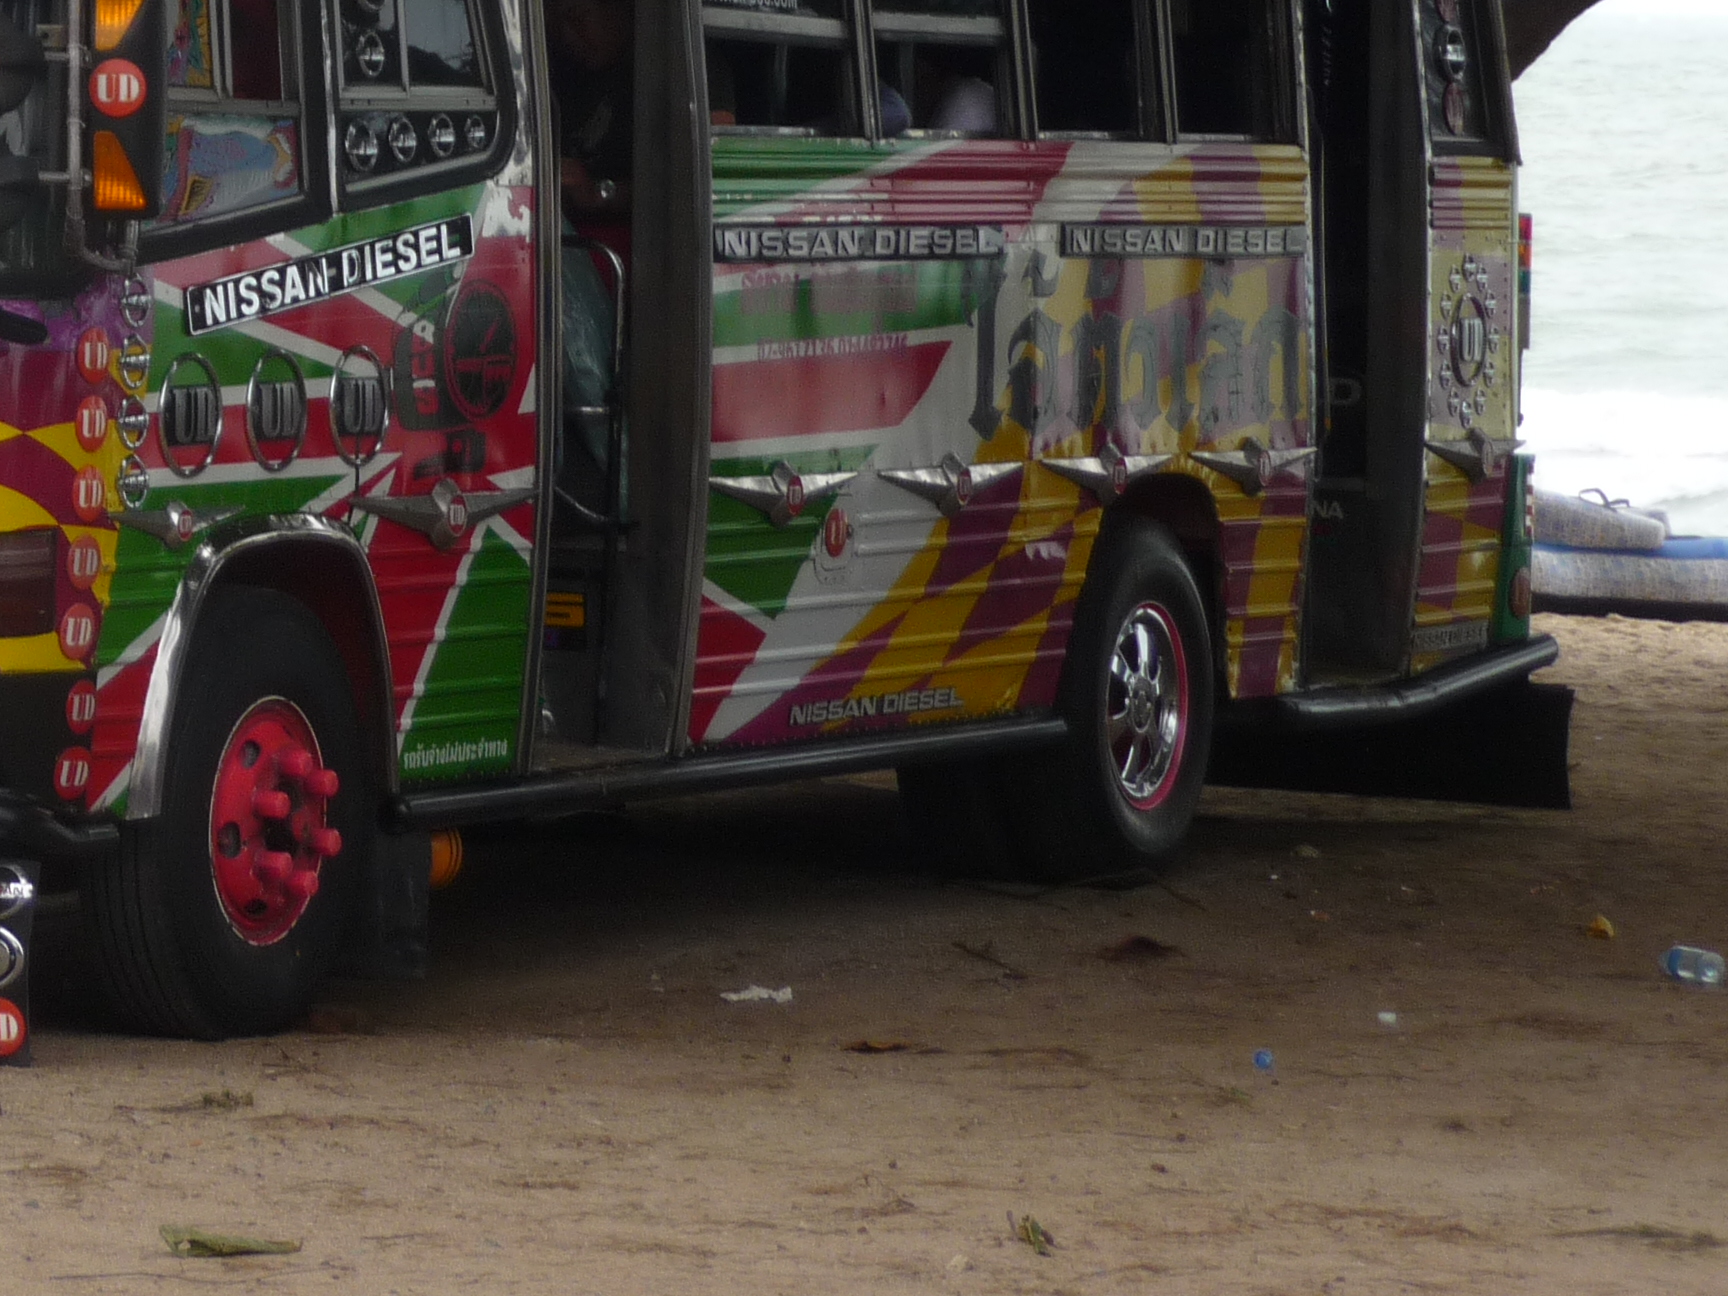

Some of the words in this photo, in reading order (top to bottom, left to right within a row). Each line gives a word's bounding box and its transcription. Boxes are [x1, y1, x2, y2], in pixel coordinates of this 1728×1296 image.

[97, 74, 139, 102] UD
[724, 230, 858, 256] NISSAN
[1072, 230, 1183, 252] NISSAN
[1195, 229, 1304, 252] DIESEL
[203, 258, 329, 326] NISSAN
[342, 223, 461, 287] DIESEL
[84, 341, 107, 370] UD
[173, 388, 215, 443] UD
[261, 383, 300, 438] UD
[344, 381, 384, 434] UD
[82, 409, 106, 438] UD
[79, 479, 103, 508] UD
[73, 549, 98, 576] UD
[66, 624, 91, 646] UD
[73, 691, 96, 714] UD
[790, 697, 876, 726] NISSAN
[883, 688, 964, 714] DIESEL
[60, 760, 89, 787] UD
